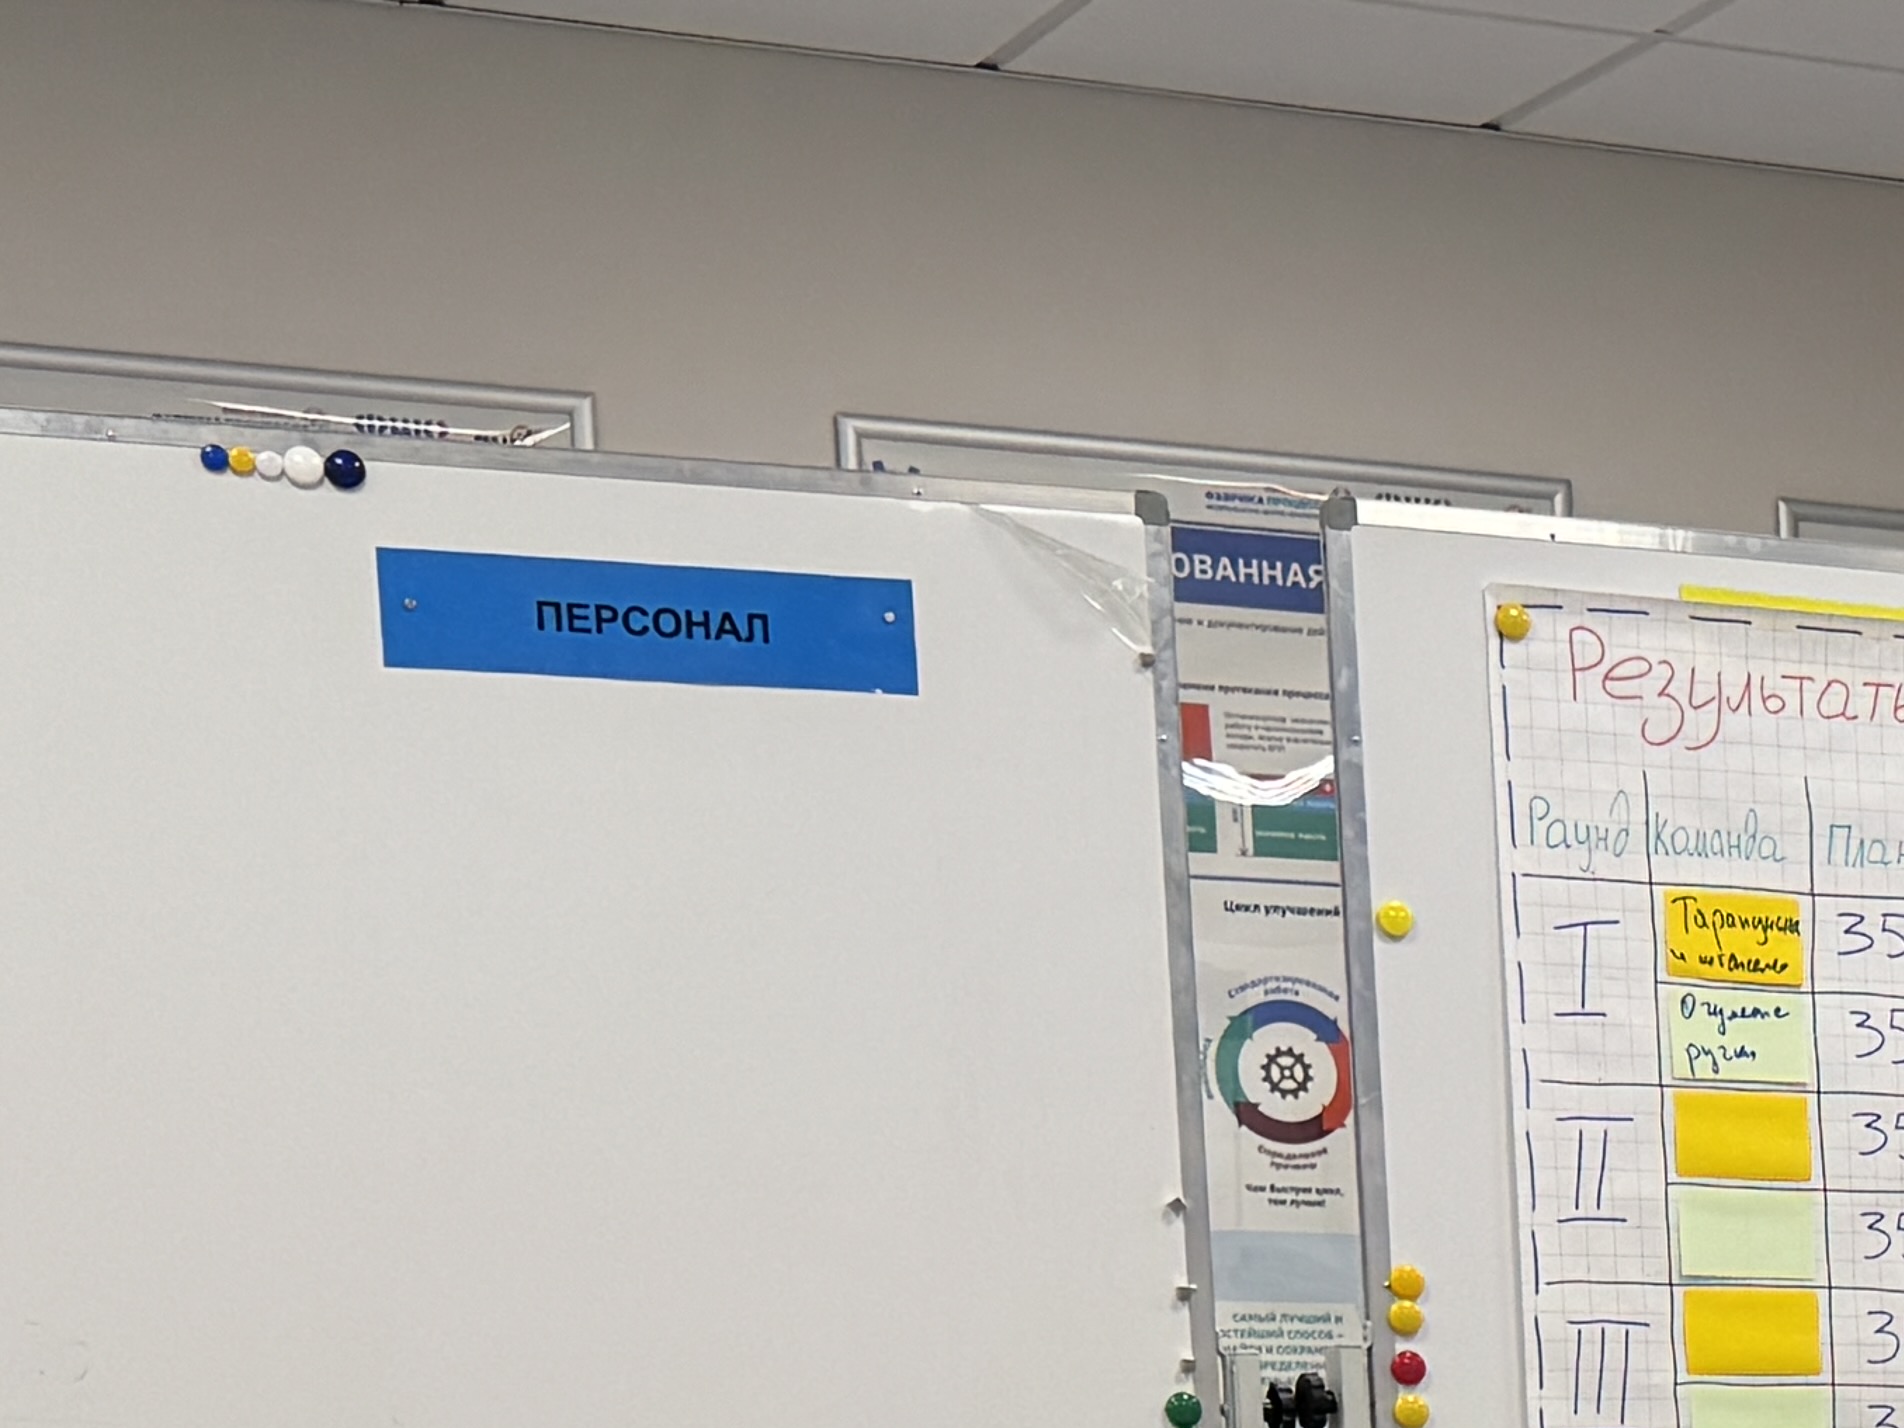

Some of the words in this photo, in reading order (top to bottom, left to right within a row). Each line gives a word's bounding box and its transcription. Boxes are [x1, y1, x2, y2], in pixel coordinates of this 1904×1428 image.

[1171, 552, 1324, 590] ОВАННАЯ
[536, 600, 770, 644] ПЕРСОНАЛ
[1528, 790, 1629, 873] Раунд
[1651, 807, 1787, 863] Команда
[1223, 899, 1261, 915] Цикл
